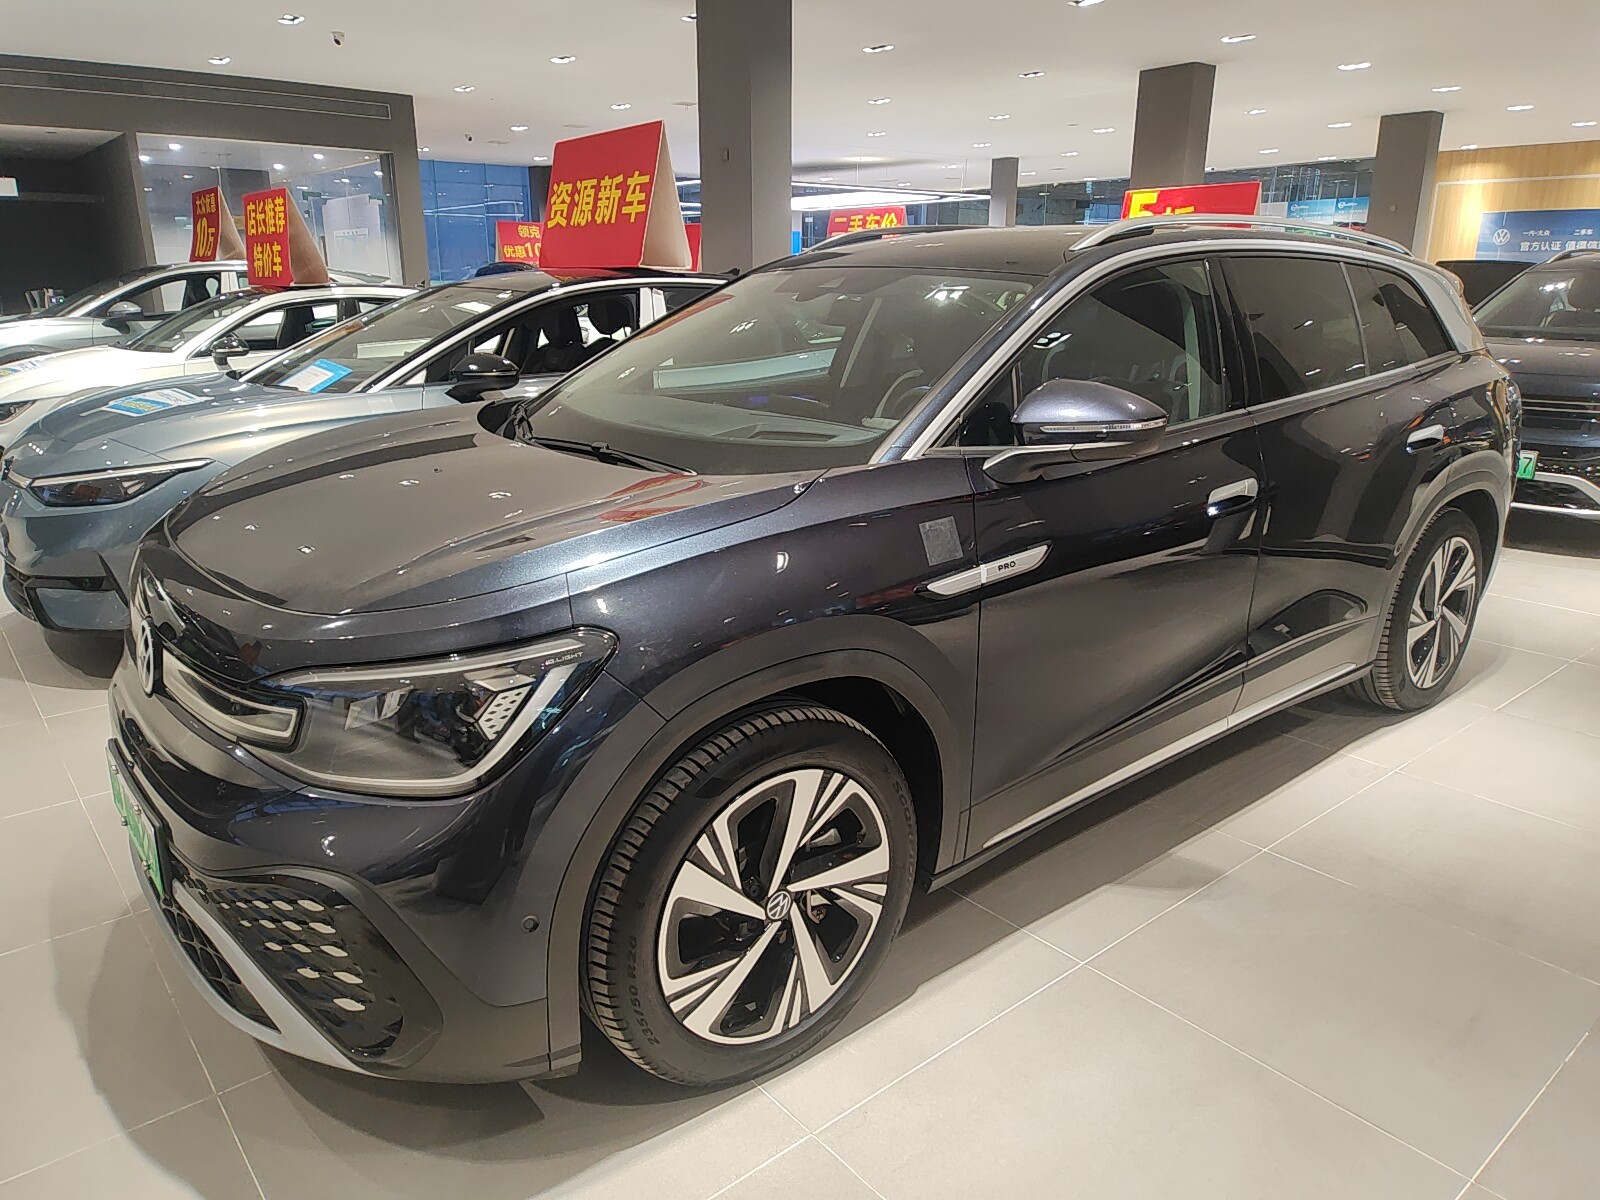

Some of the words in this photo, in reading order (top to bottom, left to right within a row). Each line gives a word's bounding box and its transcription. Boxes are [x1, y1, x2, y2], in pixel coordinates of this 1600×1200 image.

[196, 193, 217, 215] 大众优惠
[247, 196, 285, 236] 店长推荐
[547, 171, 650, 228] 资源新车
[194, 217, 216, 257] 10万
[518, 225, 540, 238] 领克
[1520, 241, 1562, 251] 官方认证
[1565, 241, 1600, 250] 值得信
[253, 241, 283, 278] 特价车
[1522, 456, 1533, 474] 7
[997, 560, 1017, 572] PRO
[626, 935, 638, 979] R20
[628, 984, 660, 1046] 235/50
